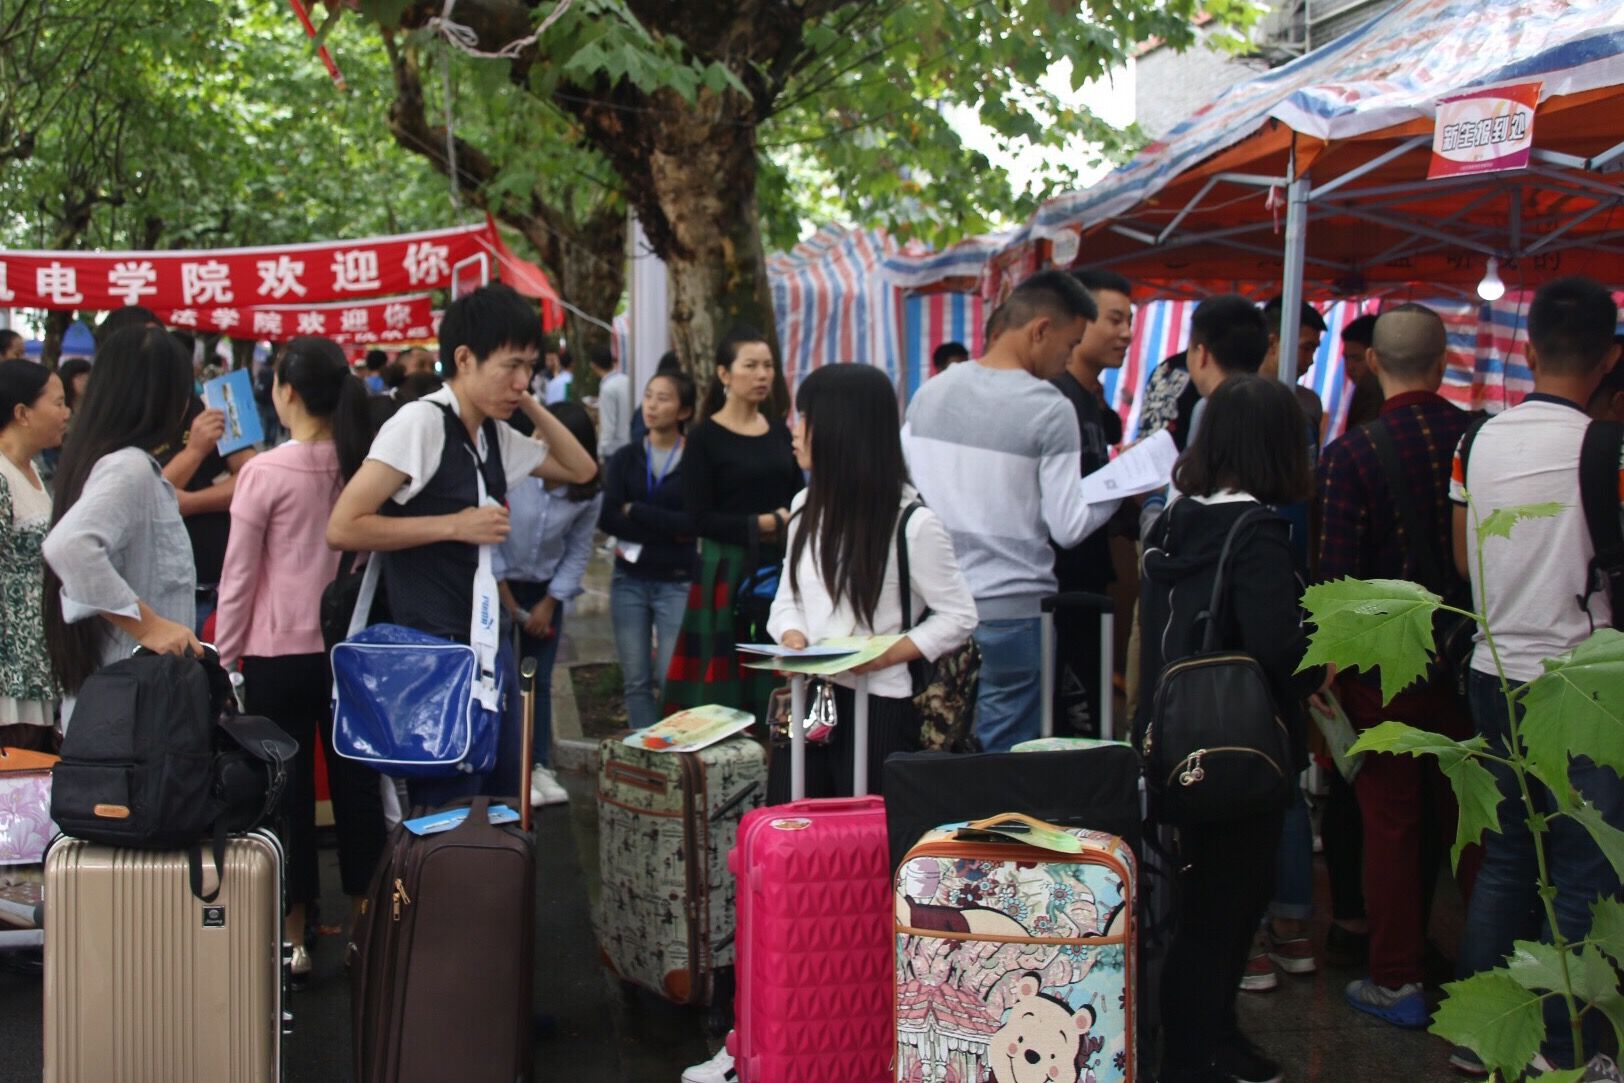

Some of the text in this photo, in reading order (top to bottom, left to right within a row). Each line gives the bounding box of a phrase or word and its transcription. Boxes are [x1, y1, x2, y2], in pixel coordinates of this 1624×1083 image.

[1441, 112, 1526, 152] 新生报到处
